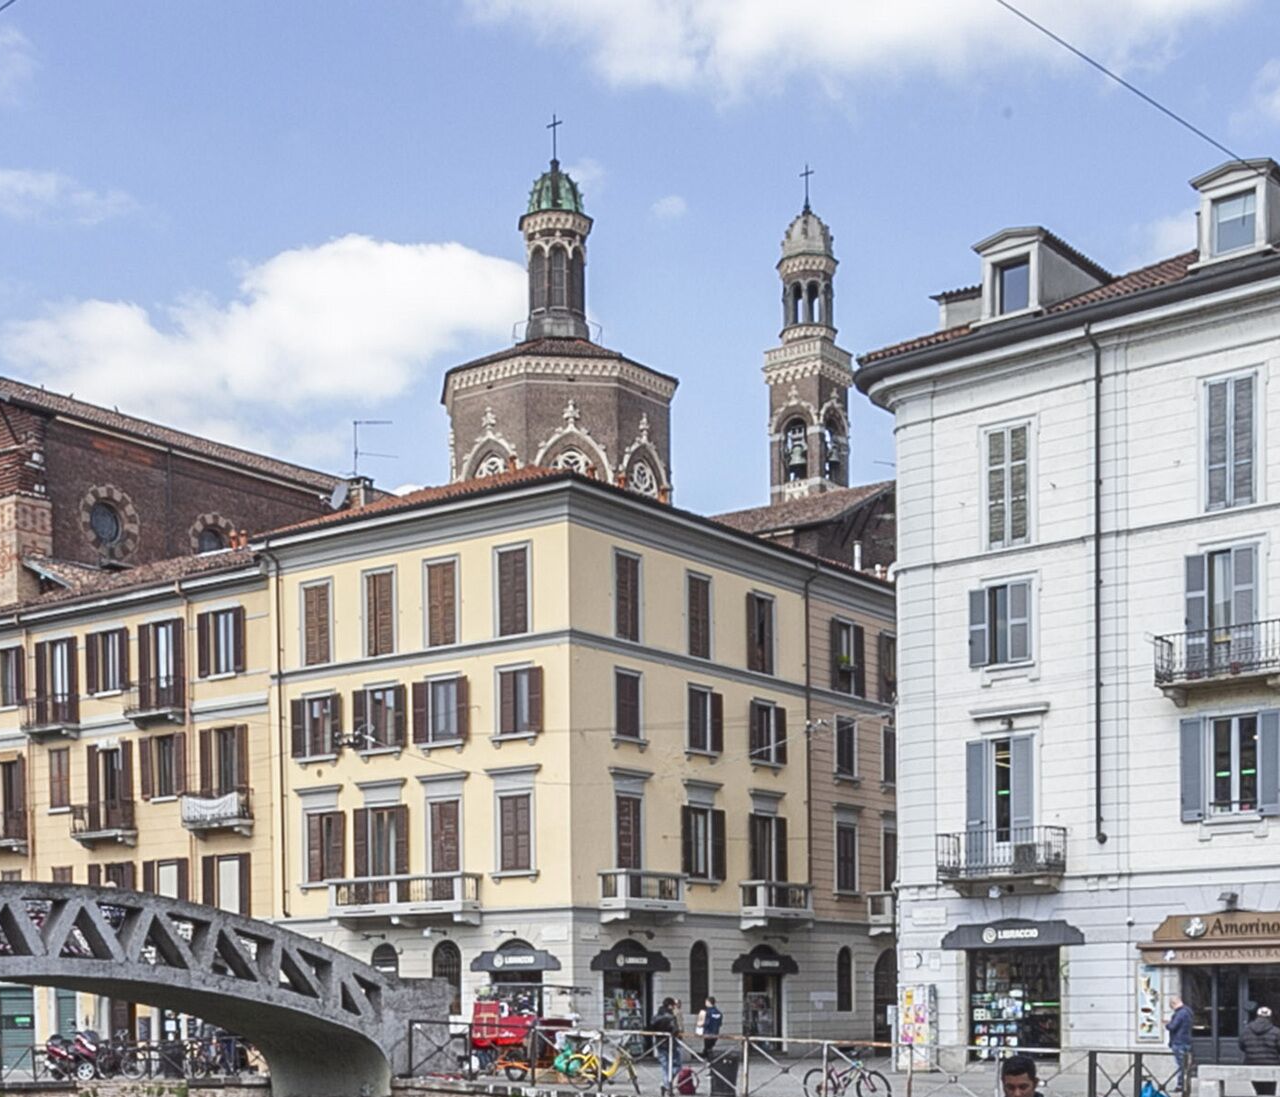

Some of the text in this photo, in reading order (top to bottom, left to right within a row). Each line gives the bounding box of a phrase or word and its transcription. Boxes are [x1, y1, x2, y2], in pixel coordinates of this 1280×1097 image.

[1210, 918, 1280, 937] Amorino
[998, 928, 1039, 940] LIBRACCIO
[1182, 951, 1221, 960] GELATO
[1222, 950, 1236, 959] AL
